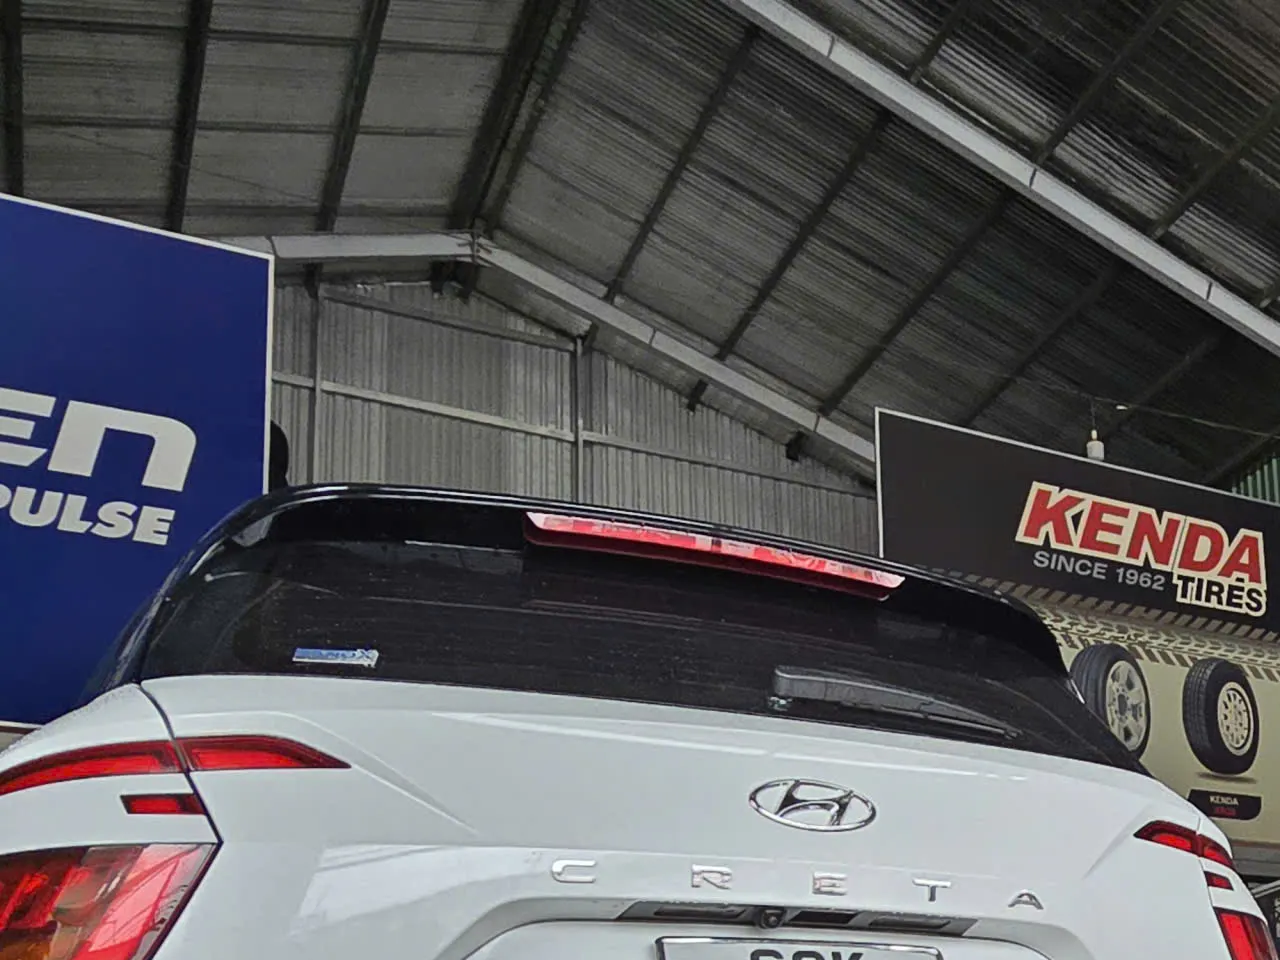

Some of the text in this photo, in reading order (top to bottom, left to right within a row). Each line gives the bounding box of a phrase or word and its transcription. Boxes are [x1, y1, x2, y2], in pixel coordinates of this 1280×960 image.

[1017, 483, 1265, 587] KENDA
[1033, 550, 1166, 591] SINCE 1962
[1175, 574, 1266, 616] TIRES
[551, 858, 1044, 911] CRETA
